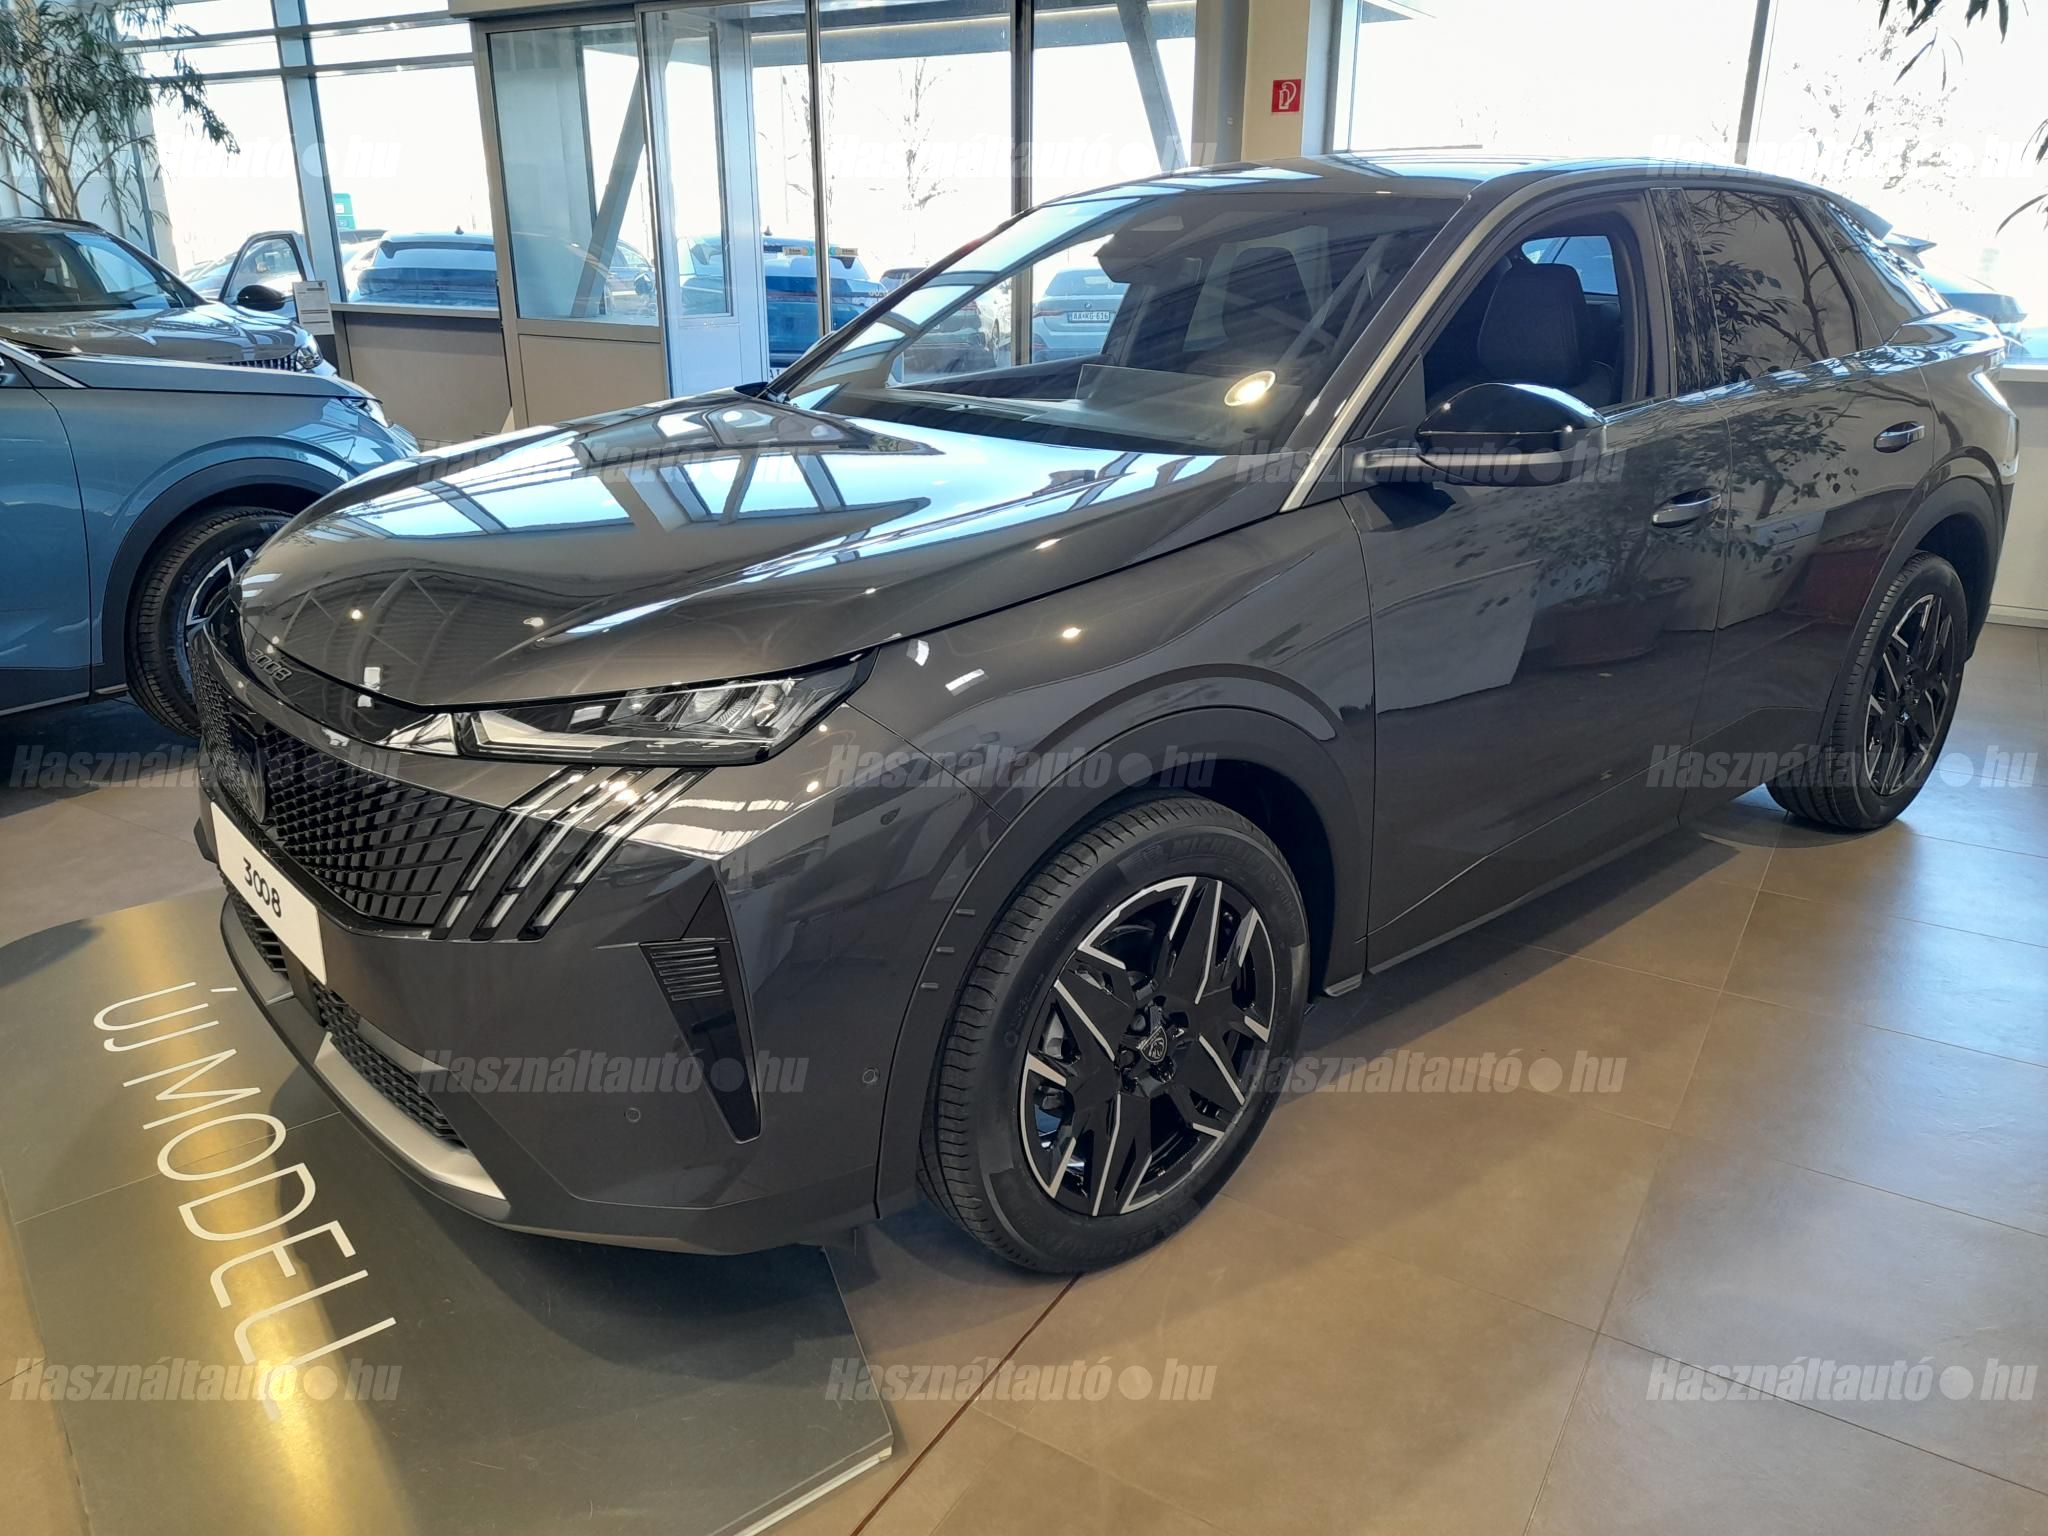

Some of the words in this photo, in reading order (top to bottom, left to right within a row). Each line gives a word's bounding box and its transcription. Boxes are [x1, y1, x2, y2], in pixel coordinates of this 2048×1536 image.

[250, 648, 292, 681] 3008
[243, 856, 282, 918] 3008
[93, 981, 238, 1052] ÚJ
[122, 1048, 396, 1421] MODELL
